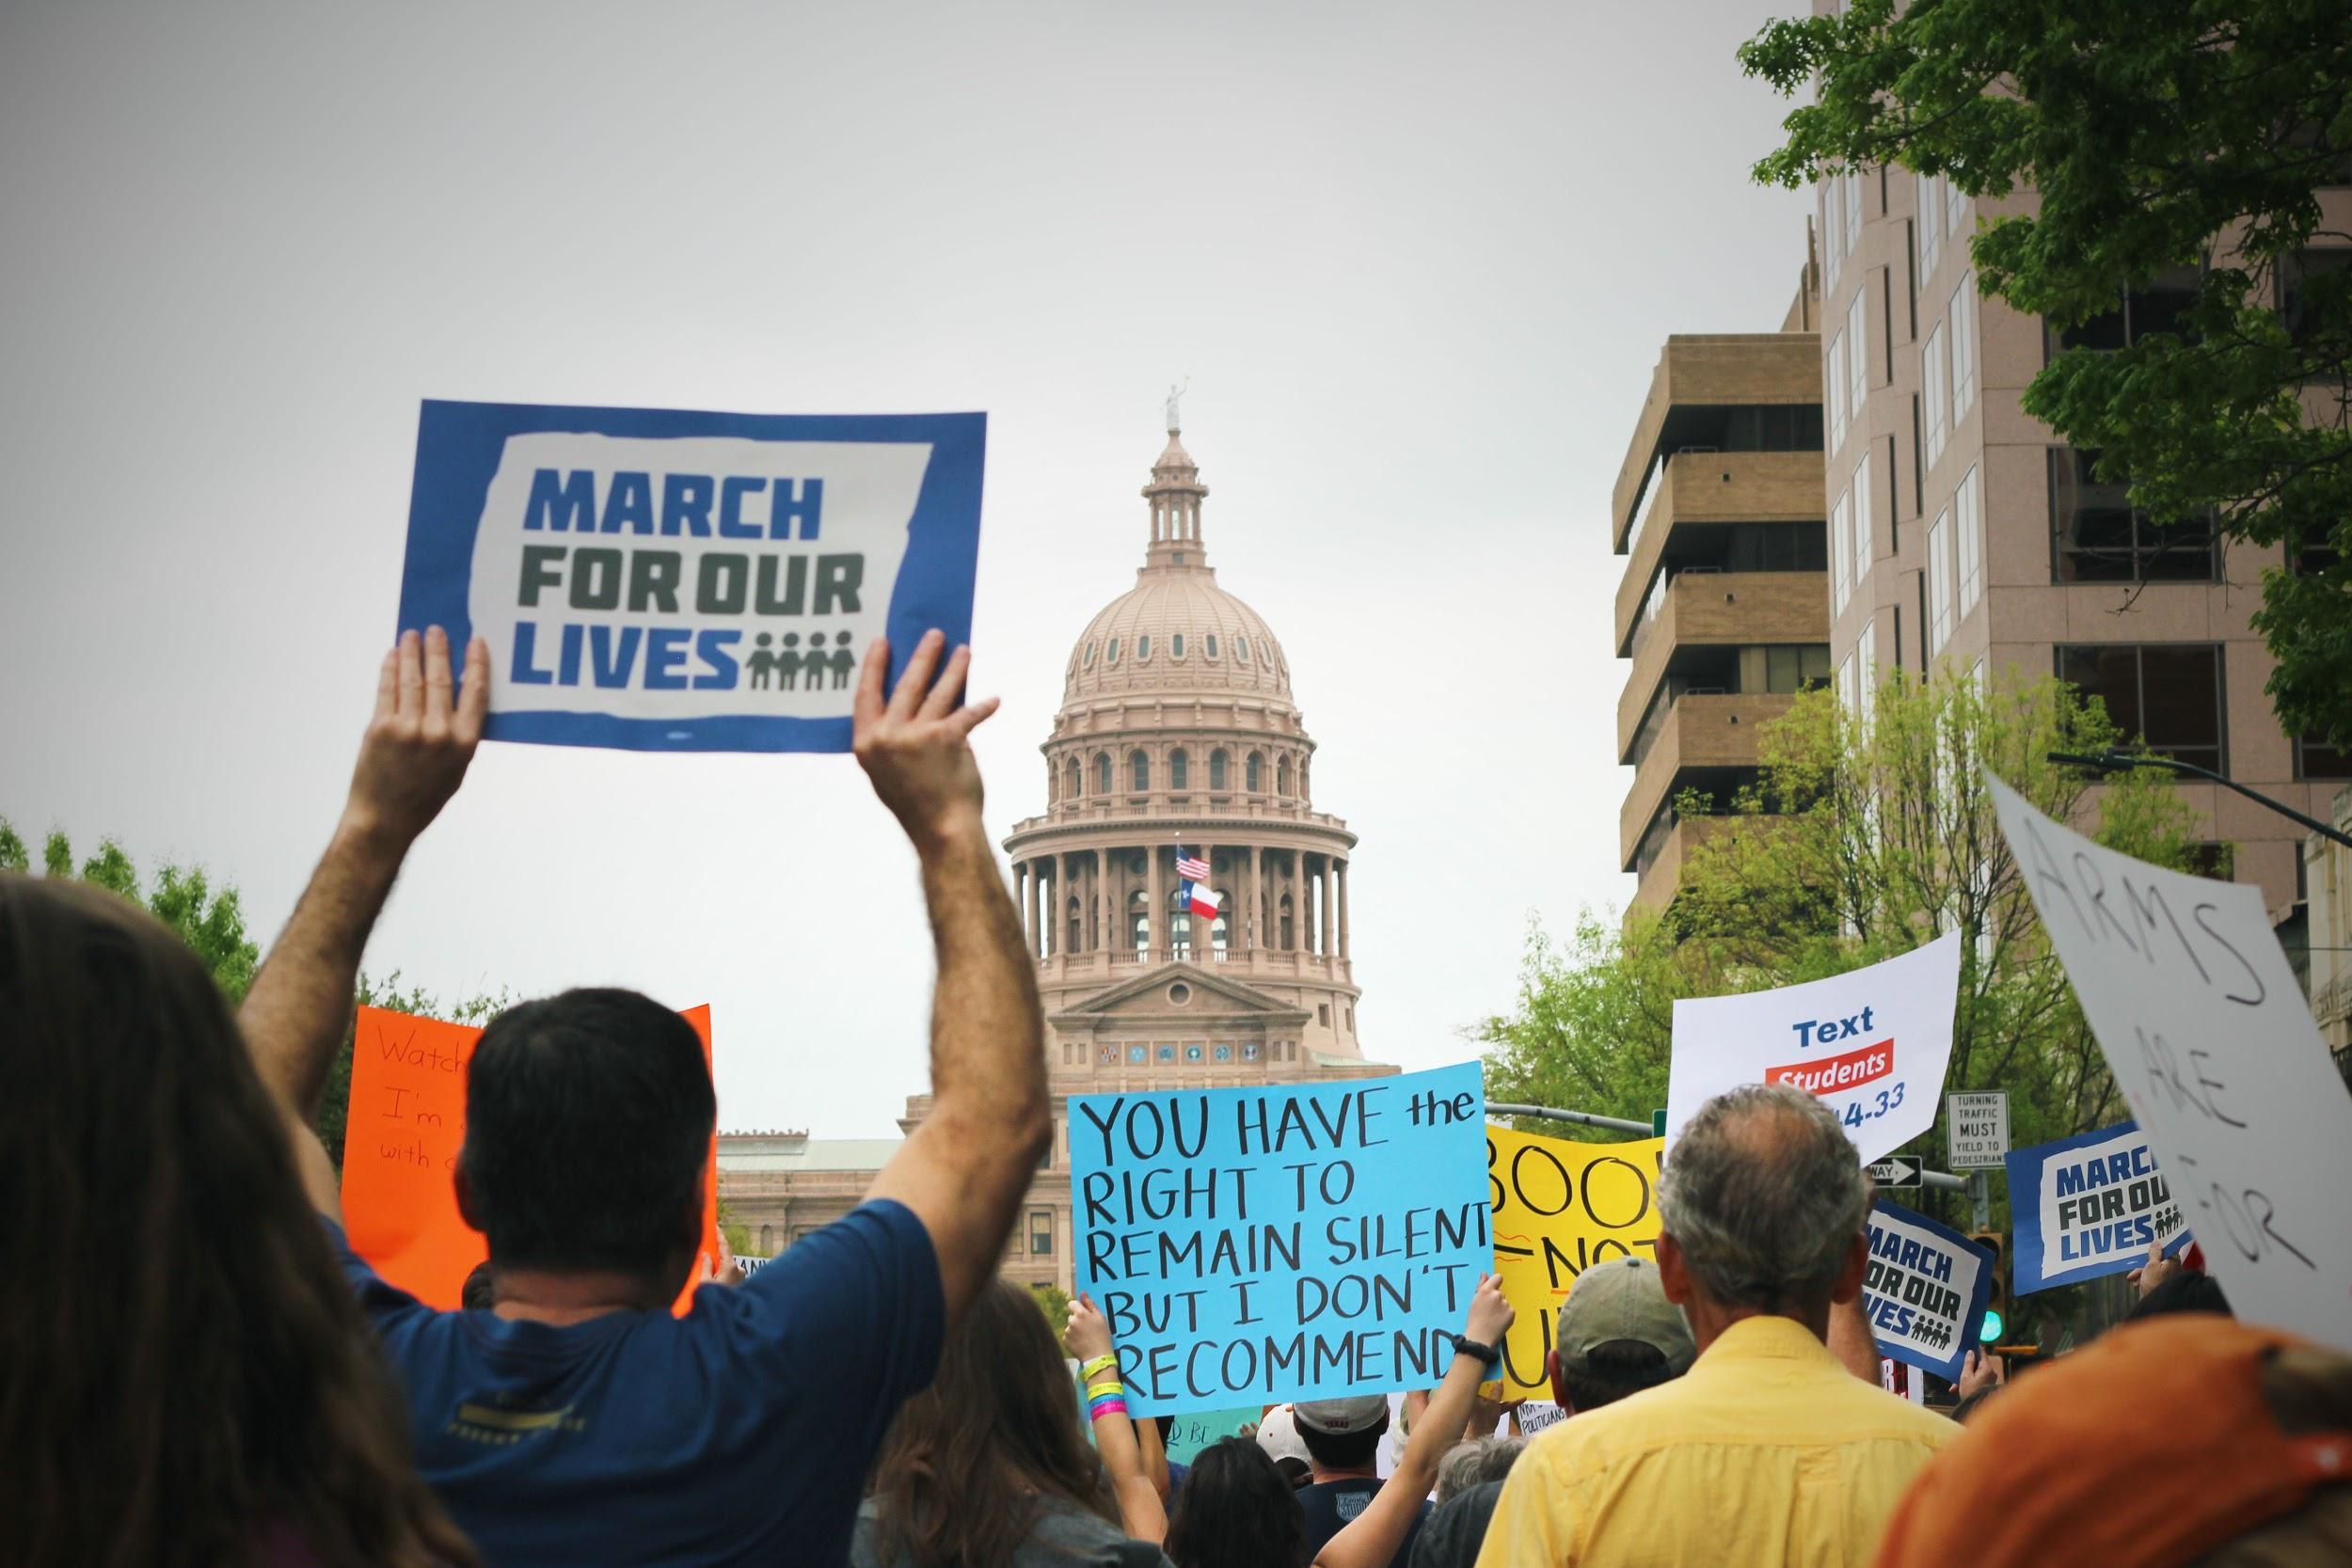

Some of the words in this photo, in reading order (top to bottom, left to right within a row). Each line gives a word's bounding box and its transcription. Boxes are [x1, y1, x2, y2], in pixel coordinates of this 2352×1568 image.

[523, 468, 823, 540] MARCH
[517, 544, 682, 613] FOR
[695, 551, 866, 616] OUR
[510, 621, 743, 691] LIVES
[2023, 816, 2266, 1006] ARMS
[377, 1023, 469, 1074] Watch
[1792, 1006, 1874, 1048] Text
[381, 1085, 442, 1128] I'm
[1079, 1095, 1208, 1166] YOU
[1238, 1085, 1390, 1155] HAVE
[1406, 1088, 1476, 1128] the
[1957, 1095, 1998, 1106] TURNING
[1959, 1108, 1997, 1118] TRAFFIC
[1960, 1122, 1997, 1137] MUST
[379, 1138, 430, 1168] with
[1956, 1142, 1983, 1152] YIELD
[1987, 1141, 1999, 1151] TO
[1083, 1166, 1257, 1228] RIGHT
[1282, 1160, 1355, 1213] TO
[1486, 1136, 1663, 1229] BOO
[2058, 1187, 2126, 1231] FOR
[2128, 1173, 2171, 1213] OU
[1087, 1222, 1302, 1284] REMAIN
[1327, 1200, 1491, 1265] SILENT
[1867, 1223, 1953, 1284] MARCH
[2060, 1213, 2154, 1262] LIVES
[1104, 1290, 1208, 1339] BUT
[1229, 1280, 1264, 1325] I
[1295, 1262, 1470, 1325] DON'T
[1863, 1259, 1905, 1298] OR
[1902, 1275, 1962, 1323] OUR
[1864, 1291, 1917, 1337] VES
[1114, 1326, 1458, 1401] RECOMMEND
[1521, 1407, 1565, 1436] POLITICIANS
